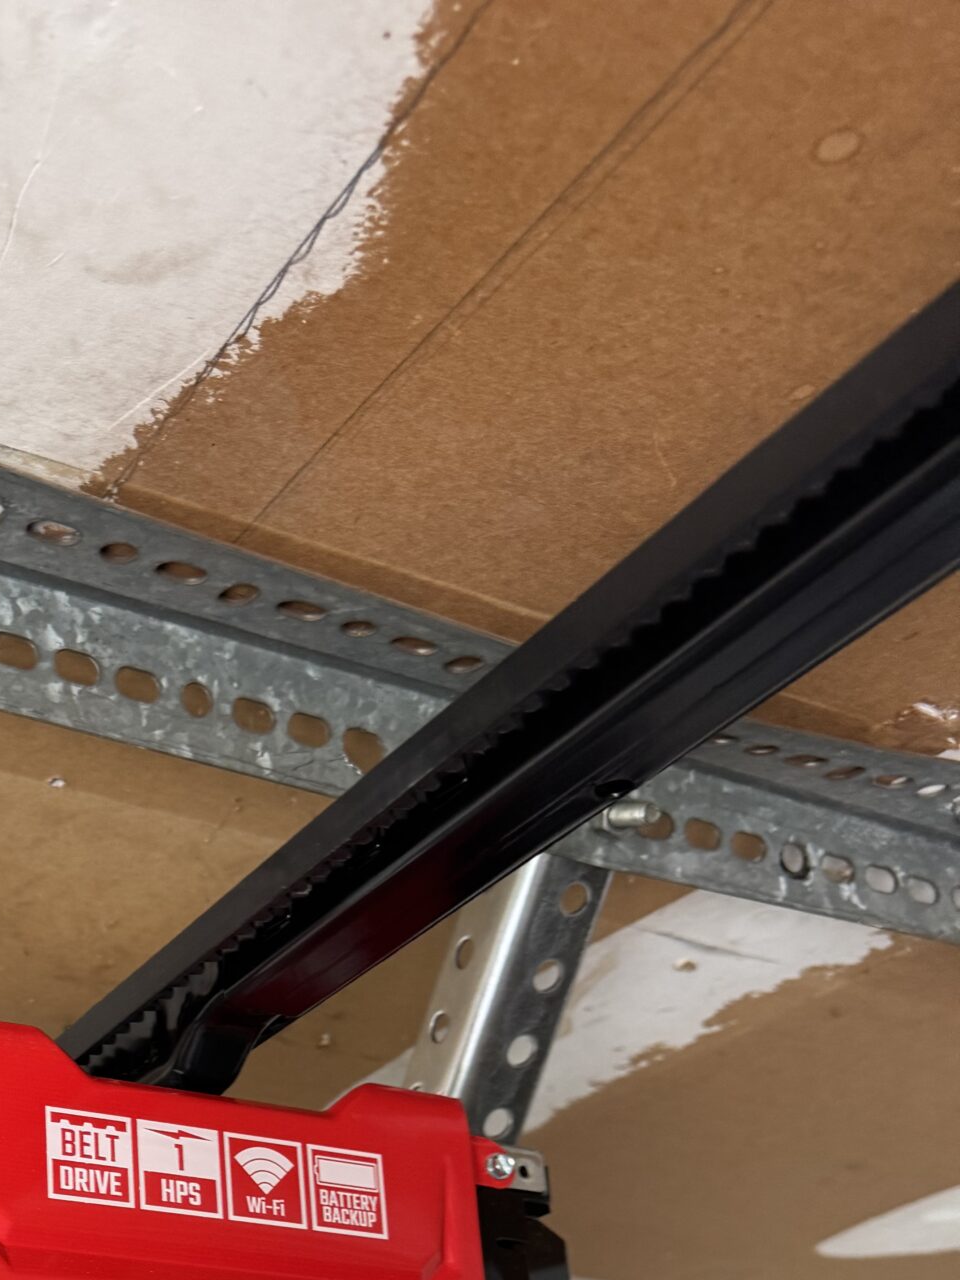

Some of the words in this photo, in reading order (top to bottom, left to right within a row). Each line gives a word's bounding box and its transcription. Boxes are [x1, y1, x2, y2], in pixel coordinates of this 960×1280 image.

[61, 1127, 120, 1162] BELT
[173, 1143, 185, 1171] 1
[59, 1165, 123, 1197] DRIVE
[160, 1178, 202, 1206] HPS
[246, 1195, 286, 1217] Wi-Fi
[319, 1188, 378, 1212] BATTERY
[322, 1206, 377, 1228] BACKUP
